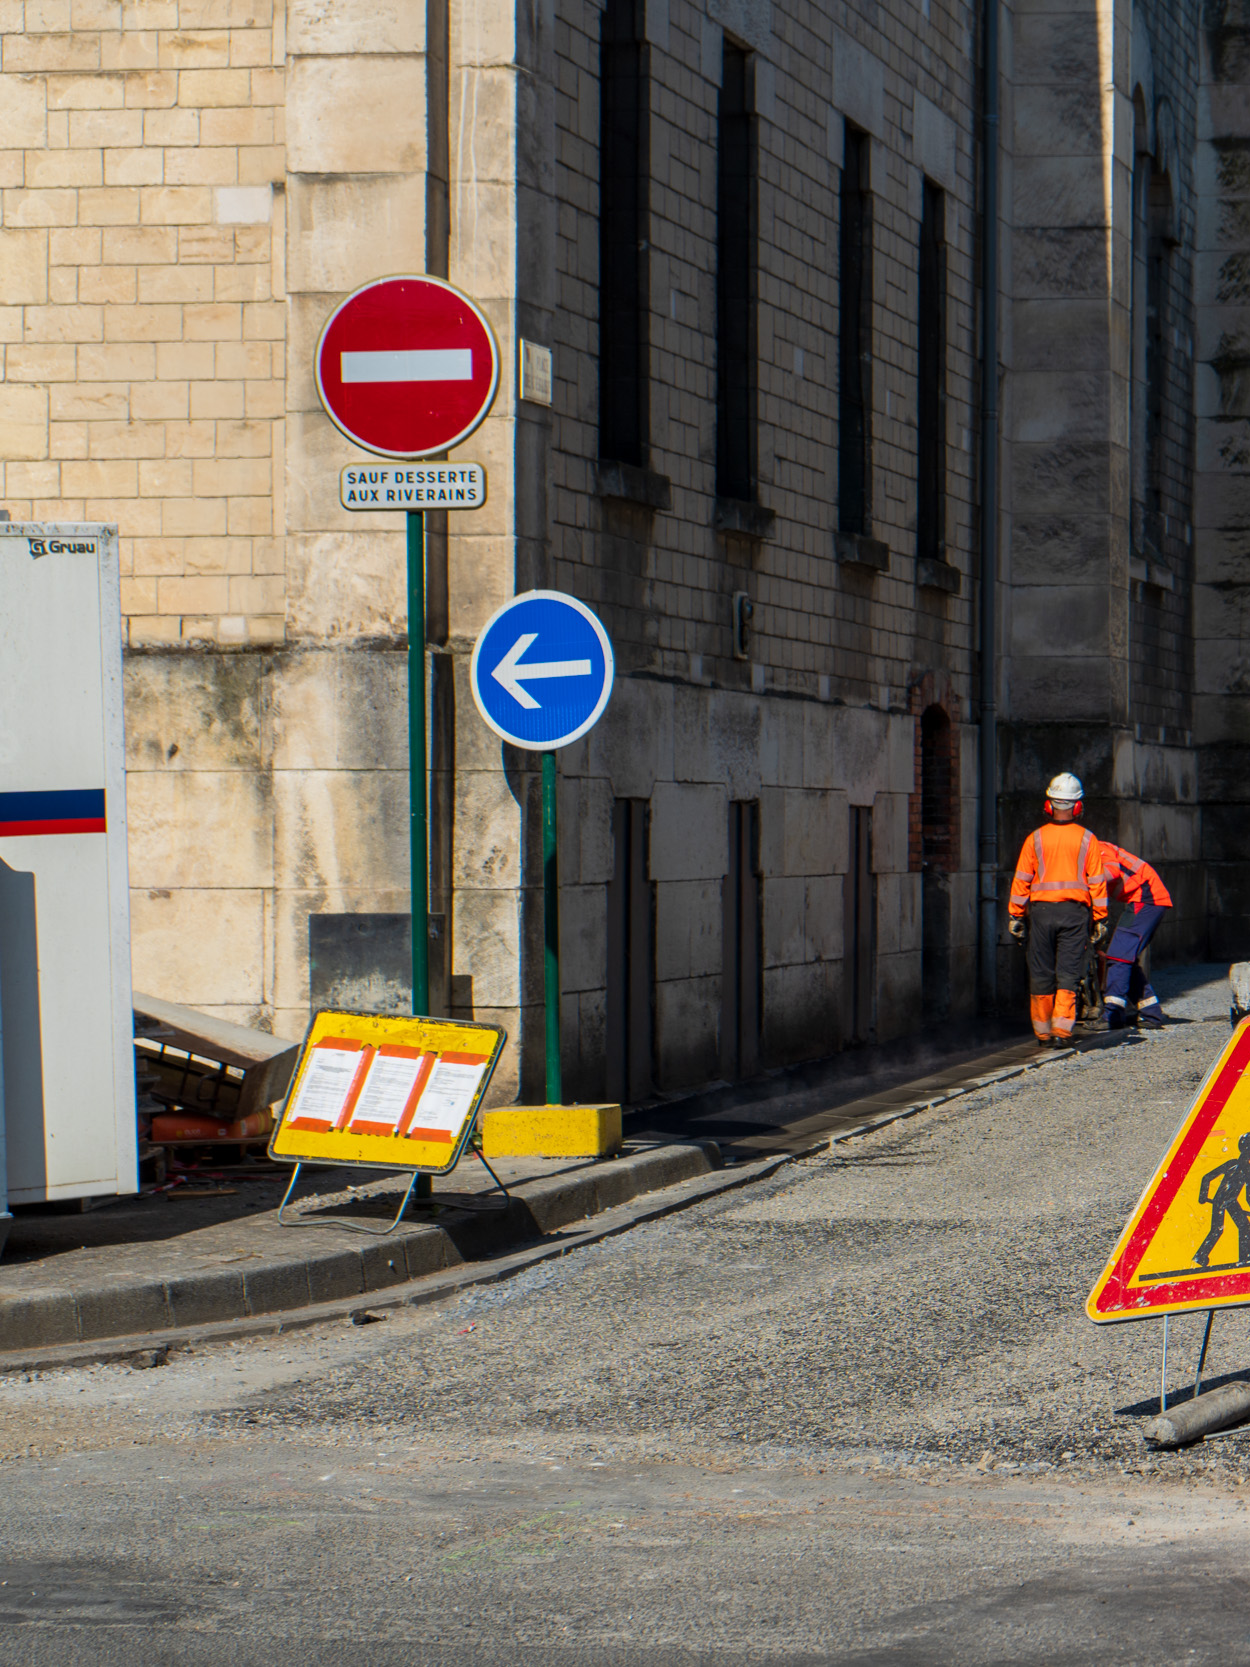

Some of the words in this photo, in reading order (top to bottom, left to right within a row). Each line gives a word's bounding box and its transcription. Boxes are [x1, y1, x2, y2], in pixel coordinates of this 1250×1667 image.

[347, 471, 389, 484] SAUF
[394, 470, 477, 484] DESSERTE
[348, 489, 379, 502] AUX
[386, 488, 477, 501] RIVERAINS
[48, 540, 96, 554] Gruau
